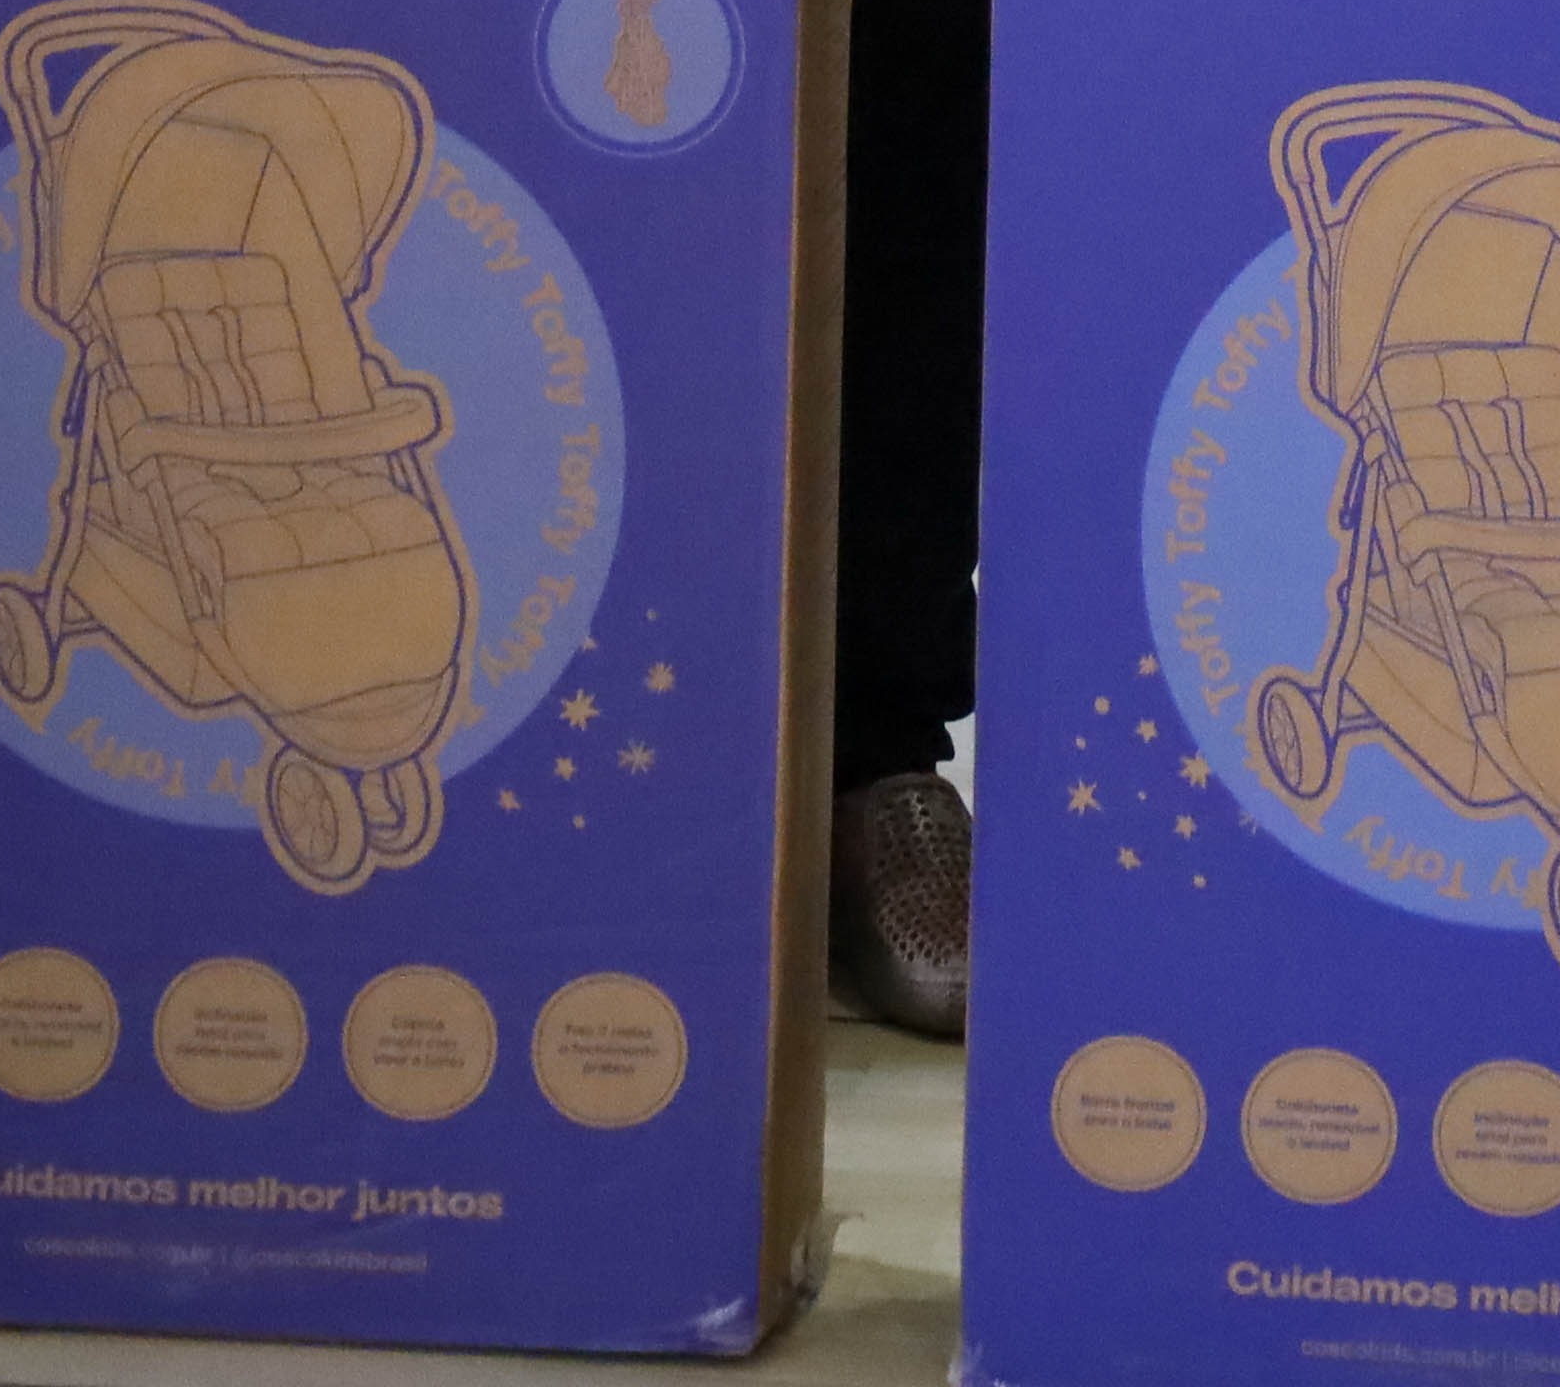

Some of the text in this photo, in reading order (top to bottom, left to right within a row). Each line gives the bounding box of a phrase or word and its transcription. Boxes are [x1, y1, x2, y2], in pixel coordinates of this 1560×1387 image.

[430, 163, 529, 273] Toffy
[519, 275, 592, 407] Toffy
[1193, 298, 1295, 416] Toffy
[548, 425, 604, 559] Toffy
[1165, 427, 1231, 563] Toffy
[1177, 577, 1241, 710] Toffy
[1344, 813, 1470, 900] Toffy
[189, 1176, 345, 1212] melhor
[352, 1180, 503, 1221] juntos
[1227, 1260, 1457, 1310] Cuidamos
